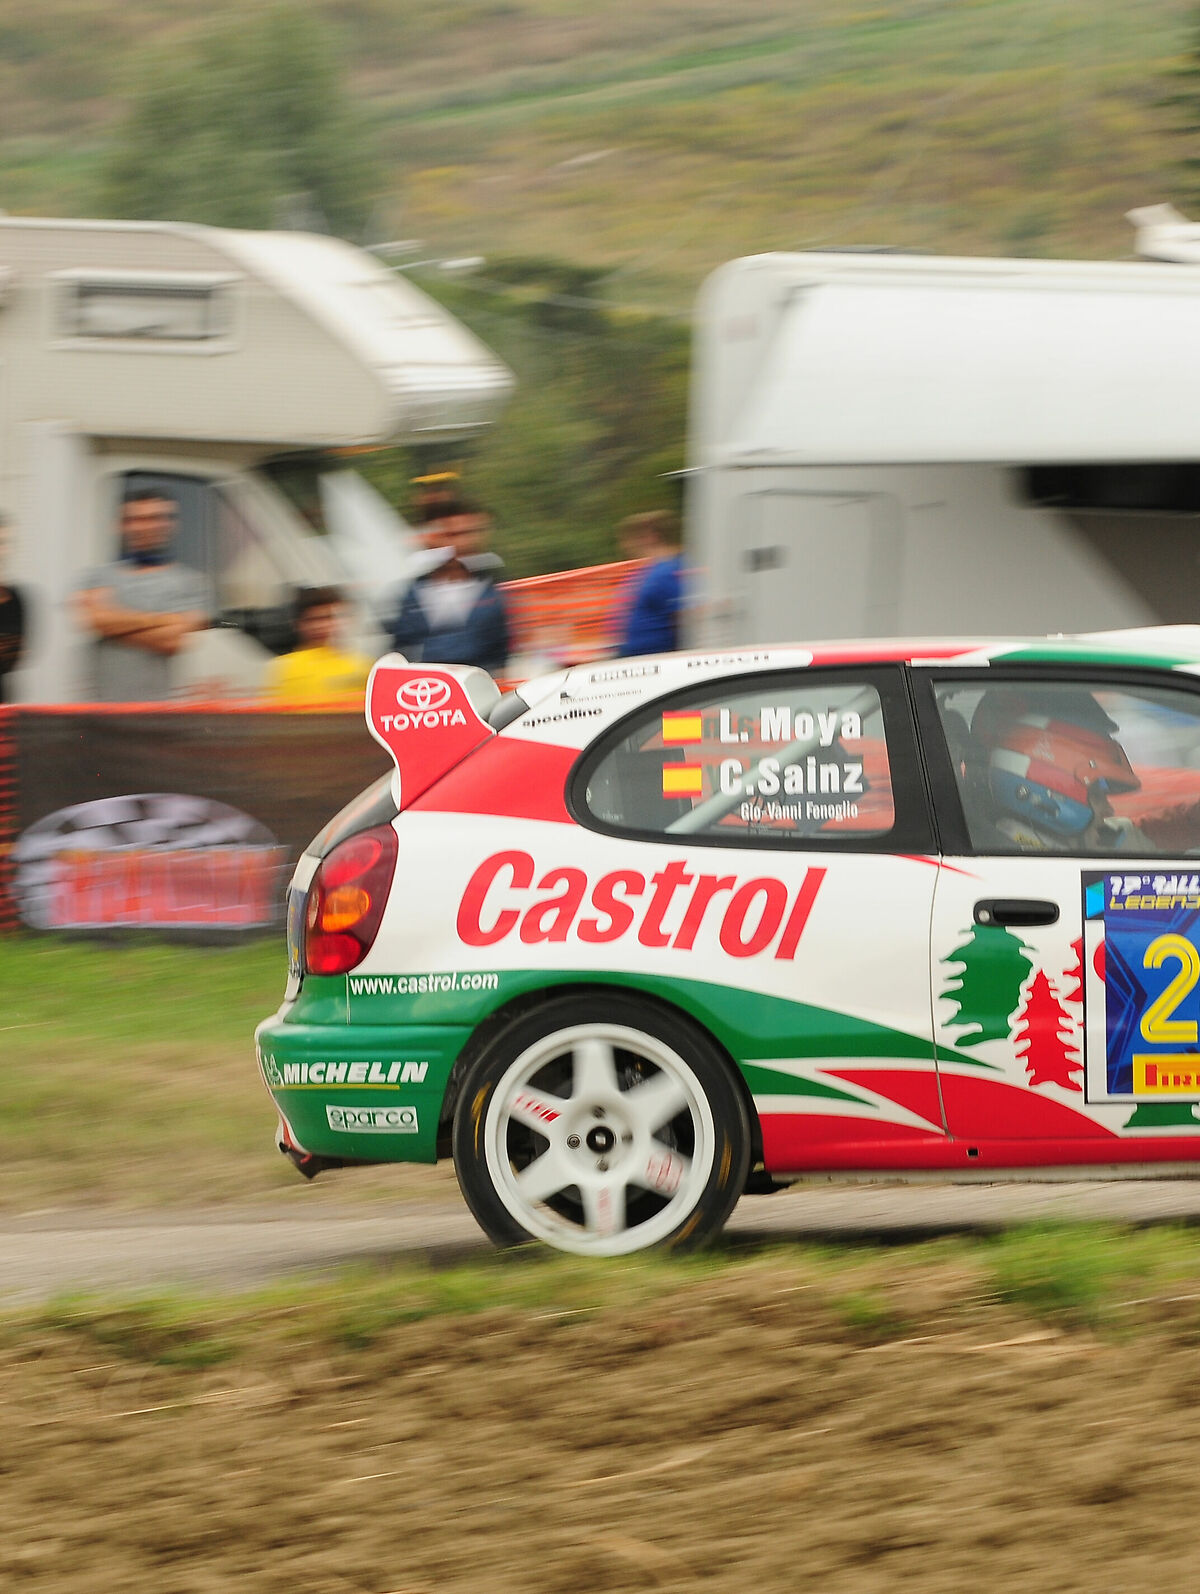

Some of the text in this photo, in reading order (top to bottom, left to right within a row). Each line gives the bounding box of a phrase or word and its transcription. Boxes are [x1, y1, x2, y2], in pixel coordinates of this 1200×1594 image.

[380, 709, 467, 732] TOYOTA
[719, 706, 862, 747] L. Moya
[805, 800, 859, 822] Fenoglio
[455, 849, 828, 961] Castrol
[349, 972, 499, 995] www.castrol.com
[283, 1061, 429, 1084] MICHELIN
[329, 1108, 415, 1129] sparco
